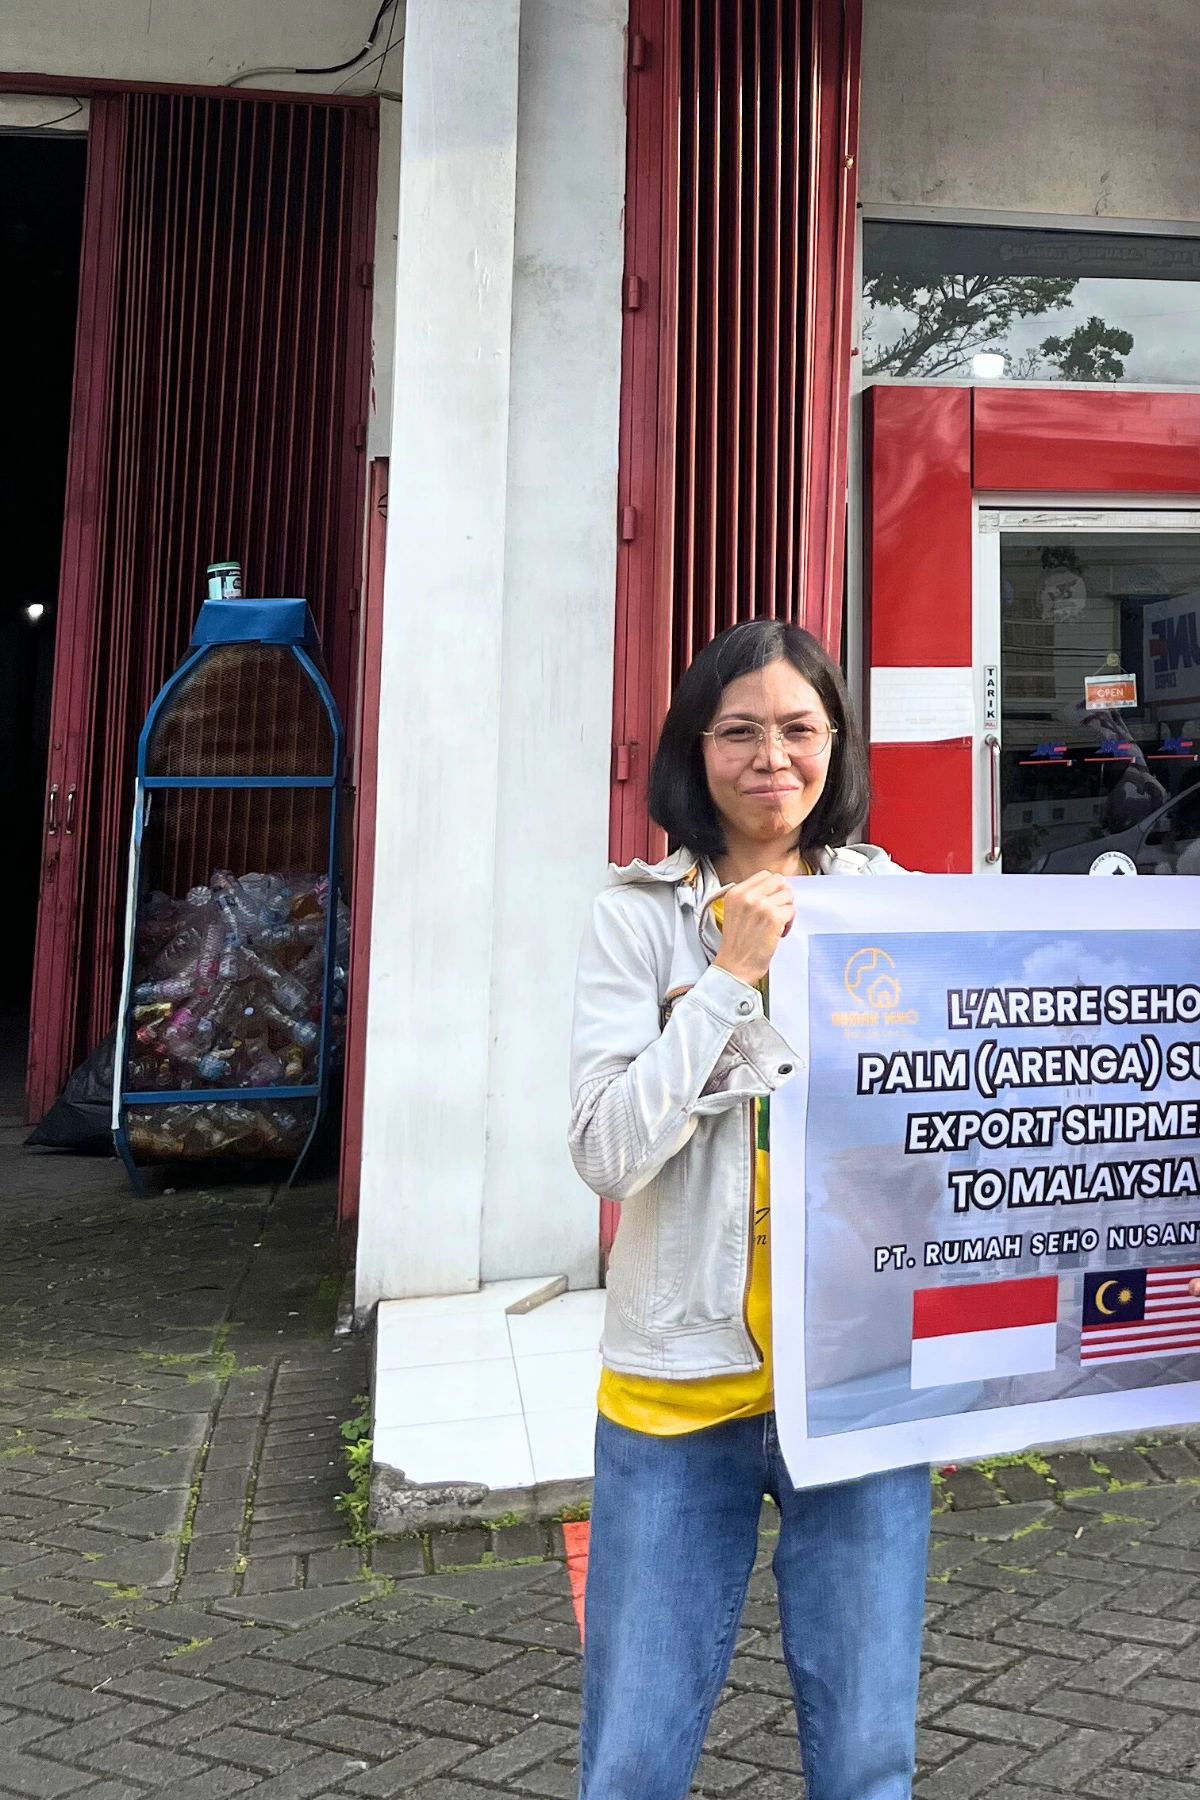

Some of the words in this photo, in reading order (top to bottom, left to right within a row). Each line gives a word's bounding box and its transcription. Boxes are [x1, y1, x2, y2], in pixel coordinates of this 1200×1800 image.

[986, 668, 995, 718] TARIK
[1097, 687, 1124, 698] OPEN
[949, 986, 1101, 1028] L'ARBRE
[858, 1046, 969, 1094] PALM
[975, 1034, 1162, 1098] (ARENGA)
[905, 1106, 1060, 1153] EXPORT
[948, 1169, 1005, 1212] TO
[1008, 1157, 1200, 1208] MALAYSIA
[874, 1246, 916, 1272] PT.
[923, 1234, 1022, 1266] RUMAH
[1030, 1229, 1099, 1256] SEHO
